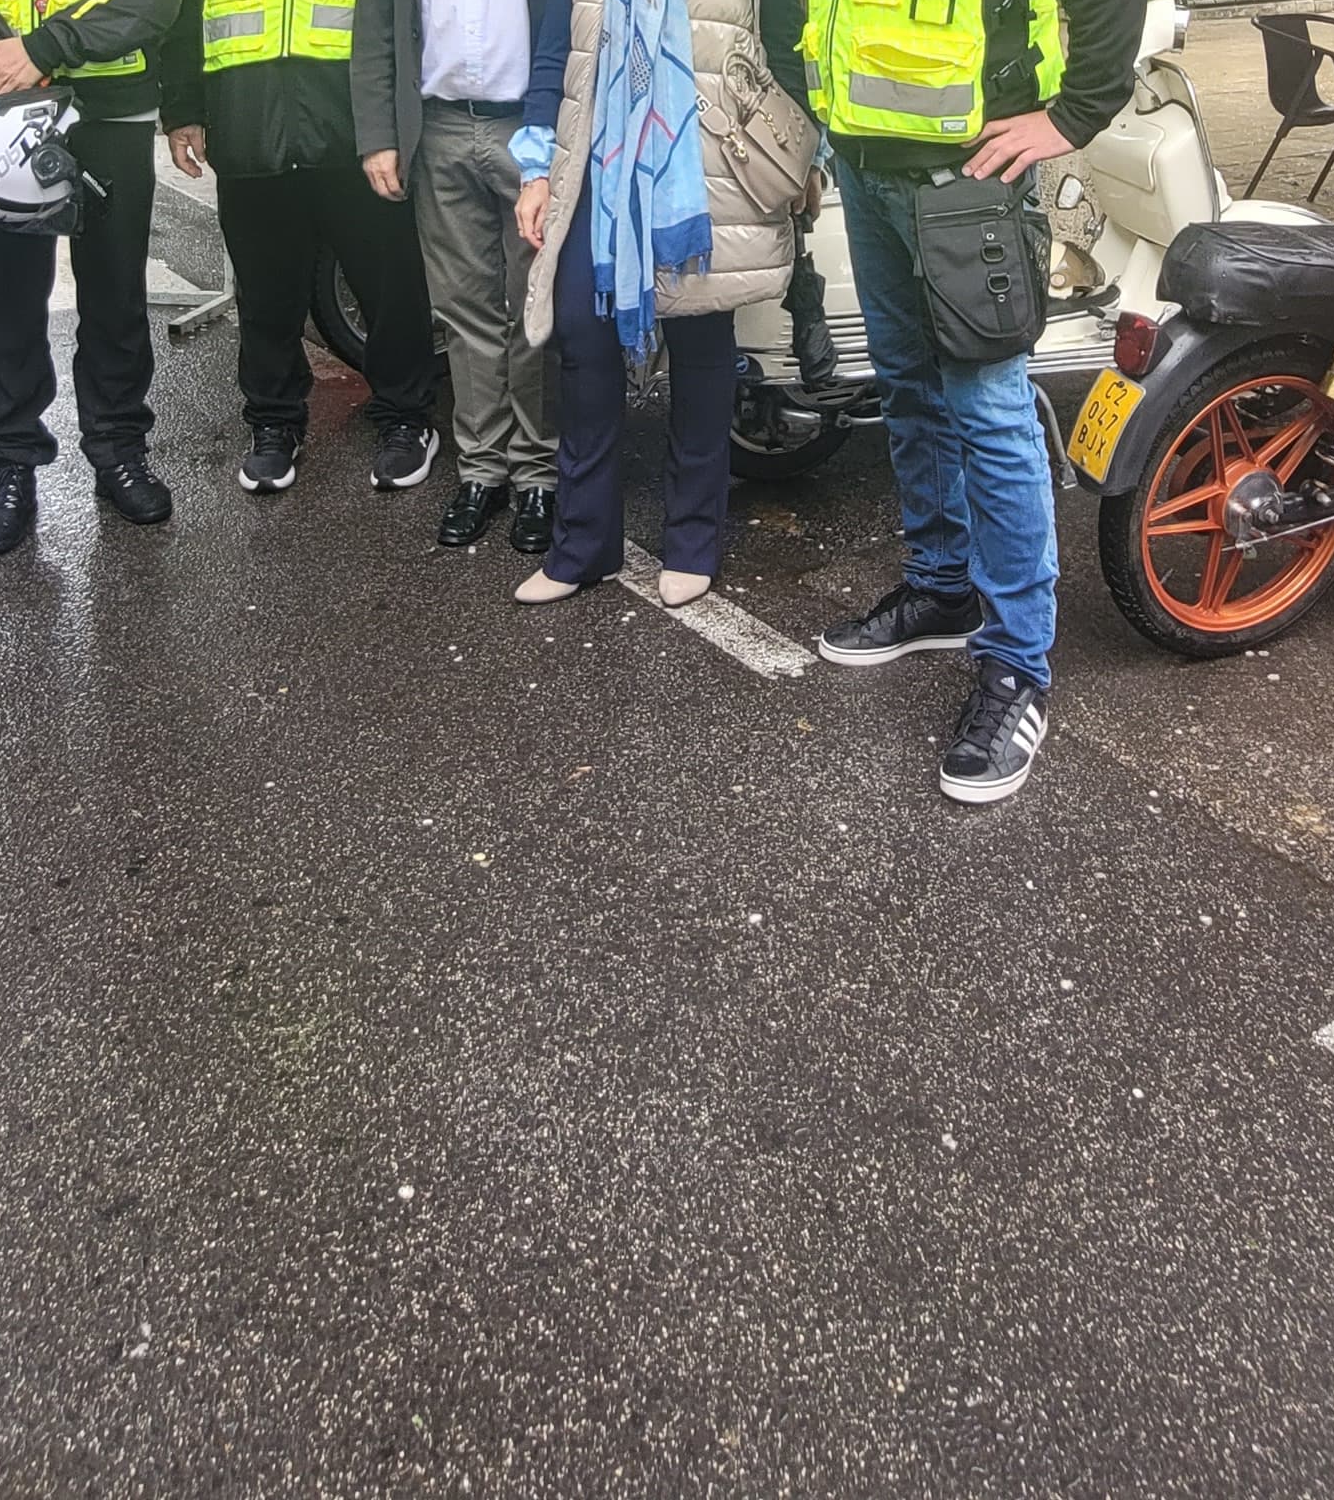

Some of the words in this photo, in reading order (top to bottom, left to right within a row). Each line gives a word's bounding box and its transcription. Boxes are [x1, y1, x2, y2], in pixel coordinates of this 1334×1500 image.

[1105, 381, 1127, 406] C2
[1088, 400, 1119, 431] 047
[1078, 423, 1107, 459] BJX
